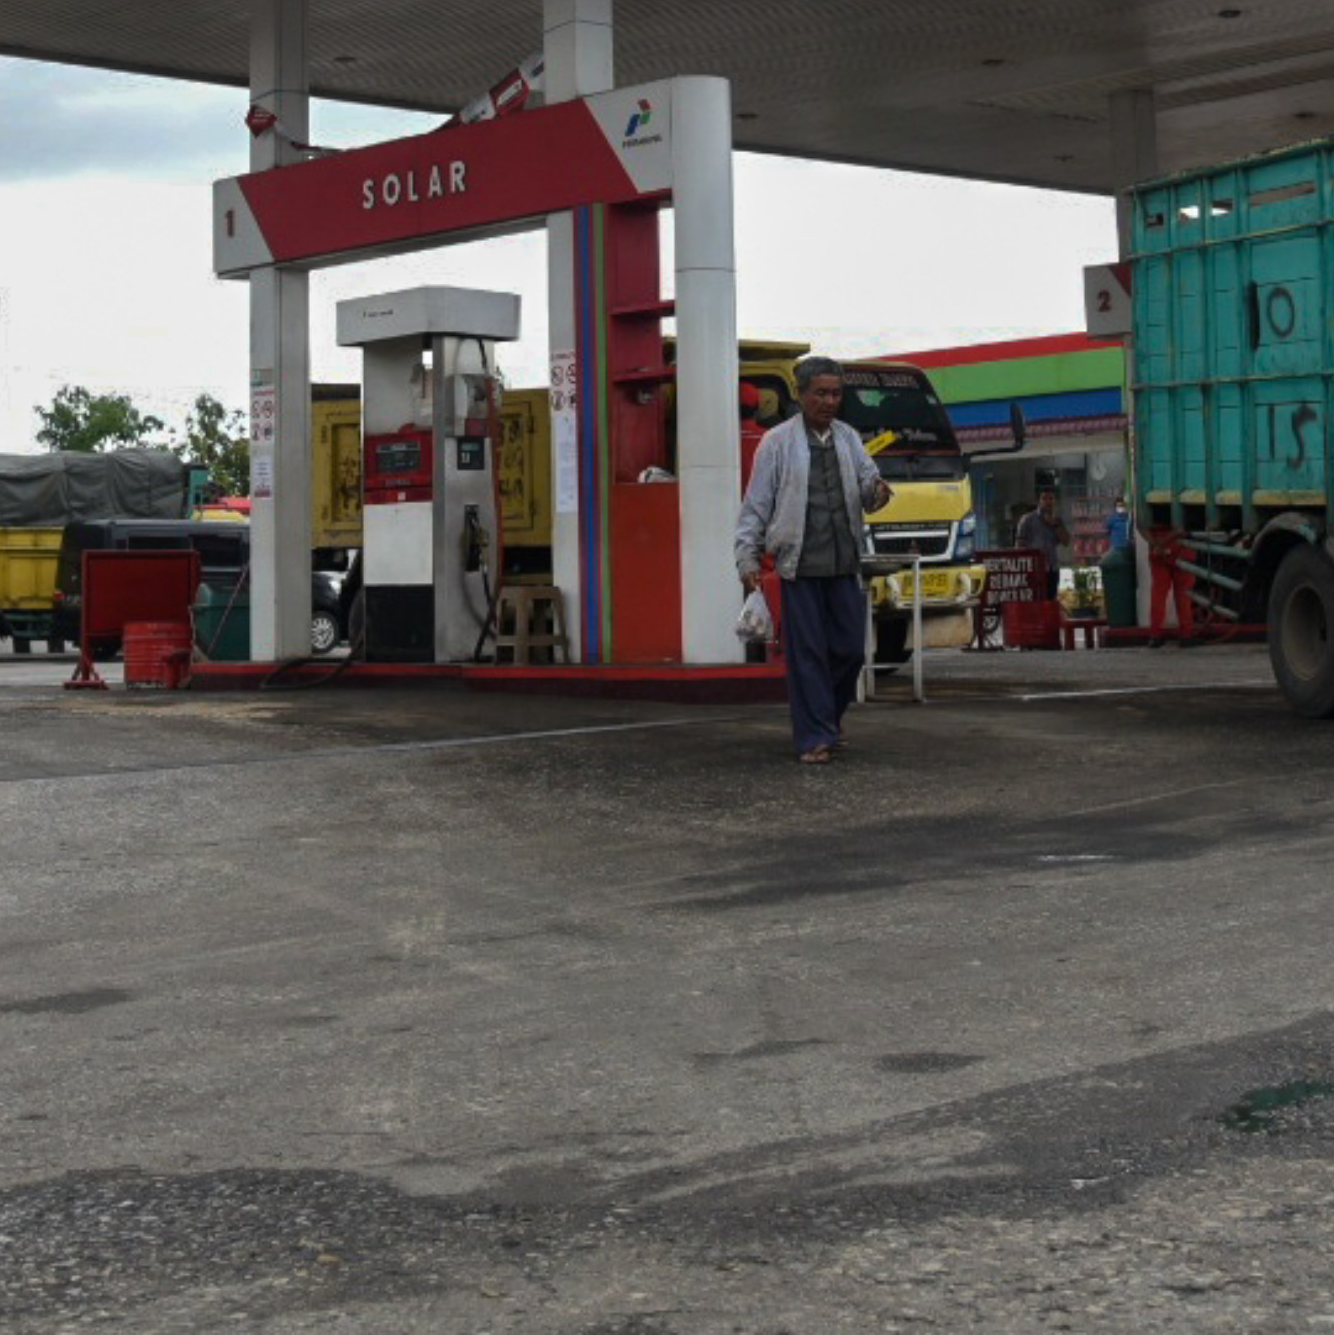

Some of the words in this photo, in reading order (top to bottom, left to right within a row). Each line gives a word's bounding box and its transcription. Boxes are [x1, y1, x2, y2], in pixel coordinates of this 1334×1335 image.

[362, 160, 466, 210] SOLAR
[225, 209, 235, 238] 1
[1097, 289, 1112, 313] 2
